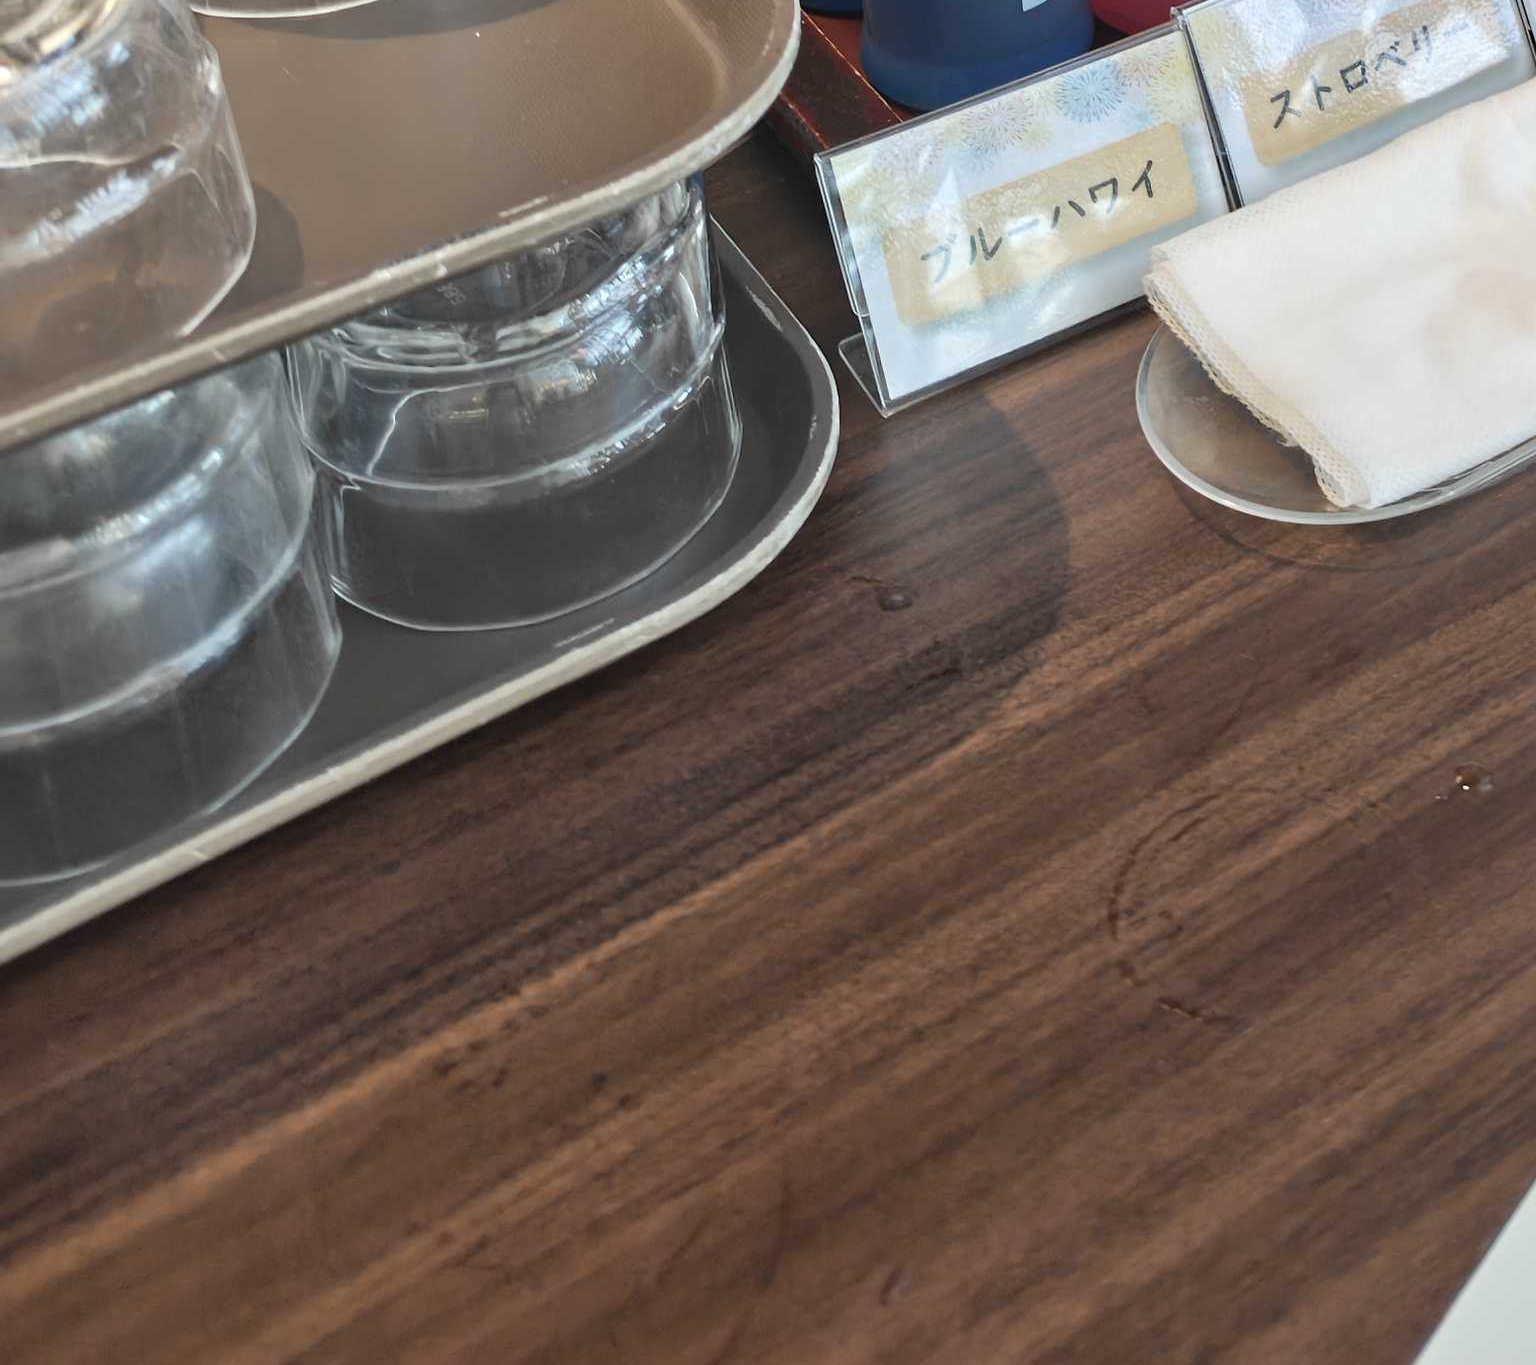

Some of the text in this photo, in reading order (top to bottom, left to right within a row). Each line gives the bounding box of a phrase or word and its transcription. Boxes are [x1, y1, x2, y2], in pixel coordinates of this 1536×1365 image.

[1270, 20, 1474, 129] ストロベリー
[921, 160, 1153, 284] ブルーハワイ
